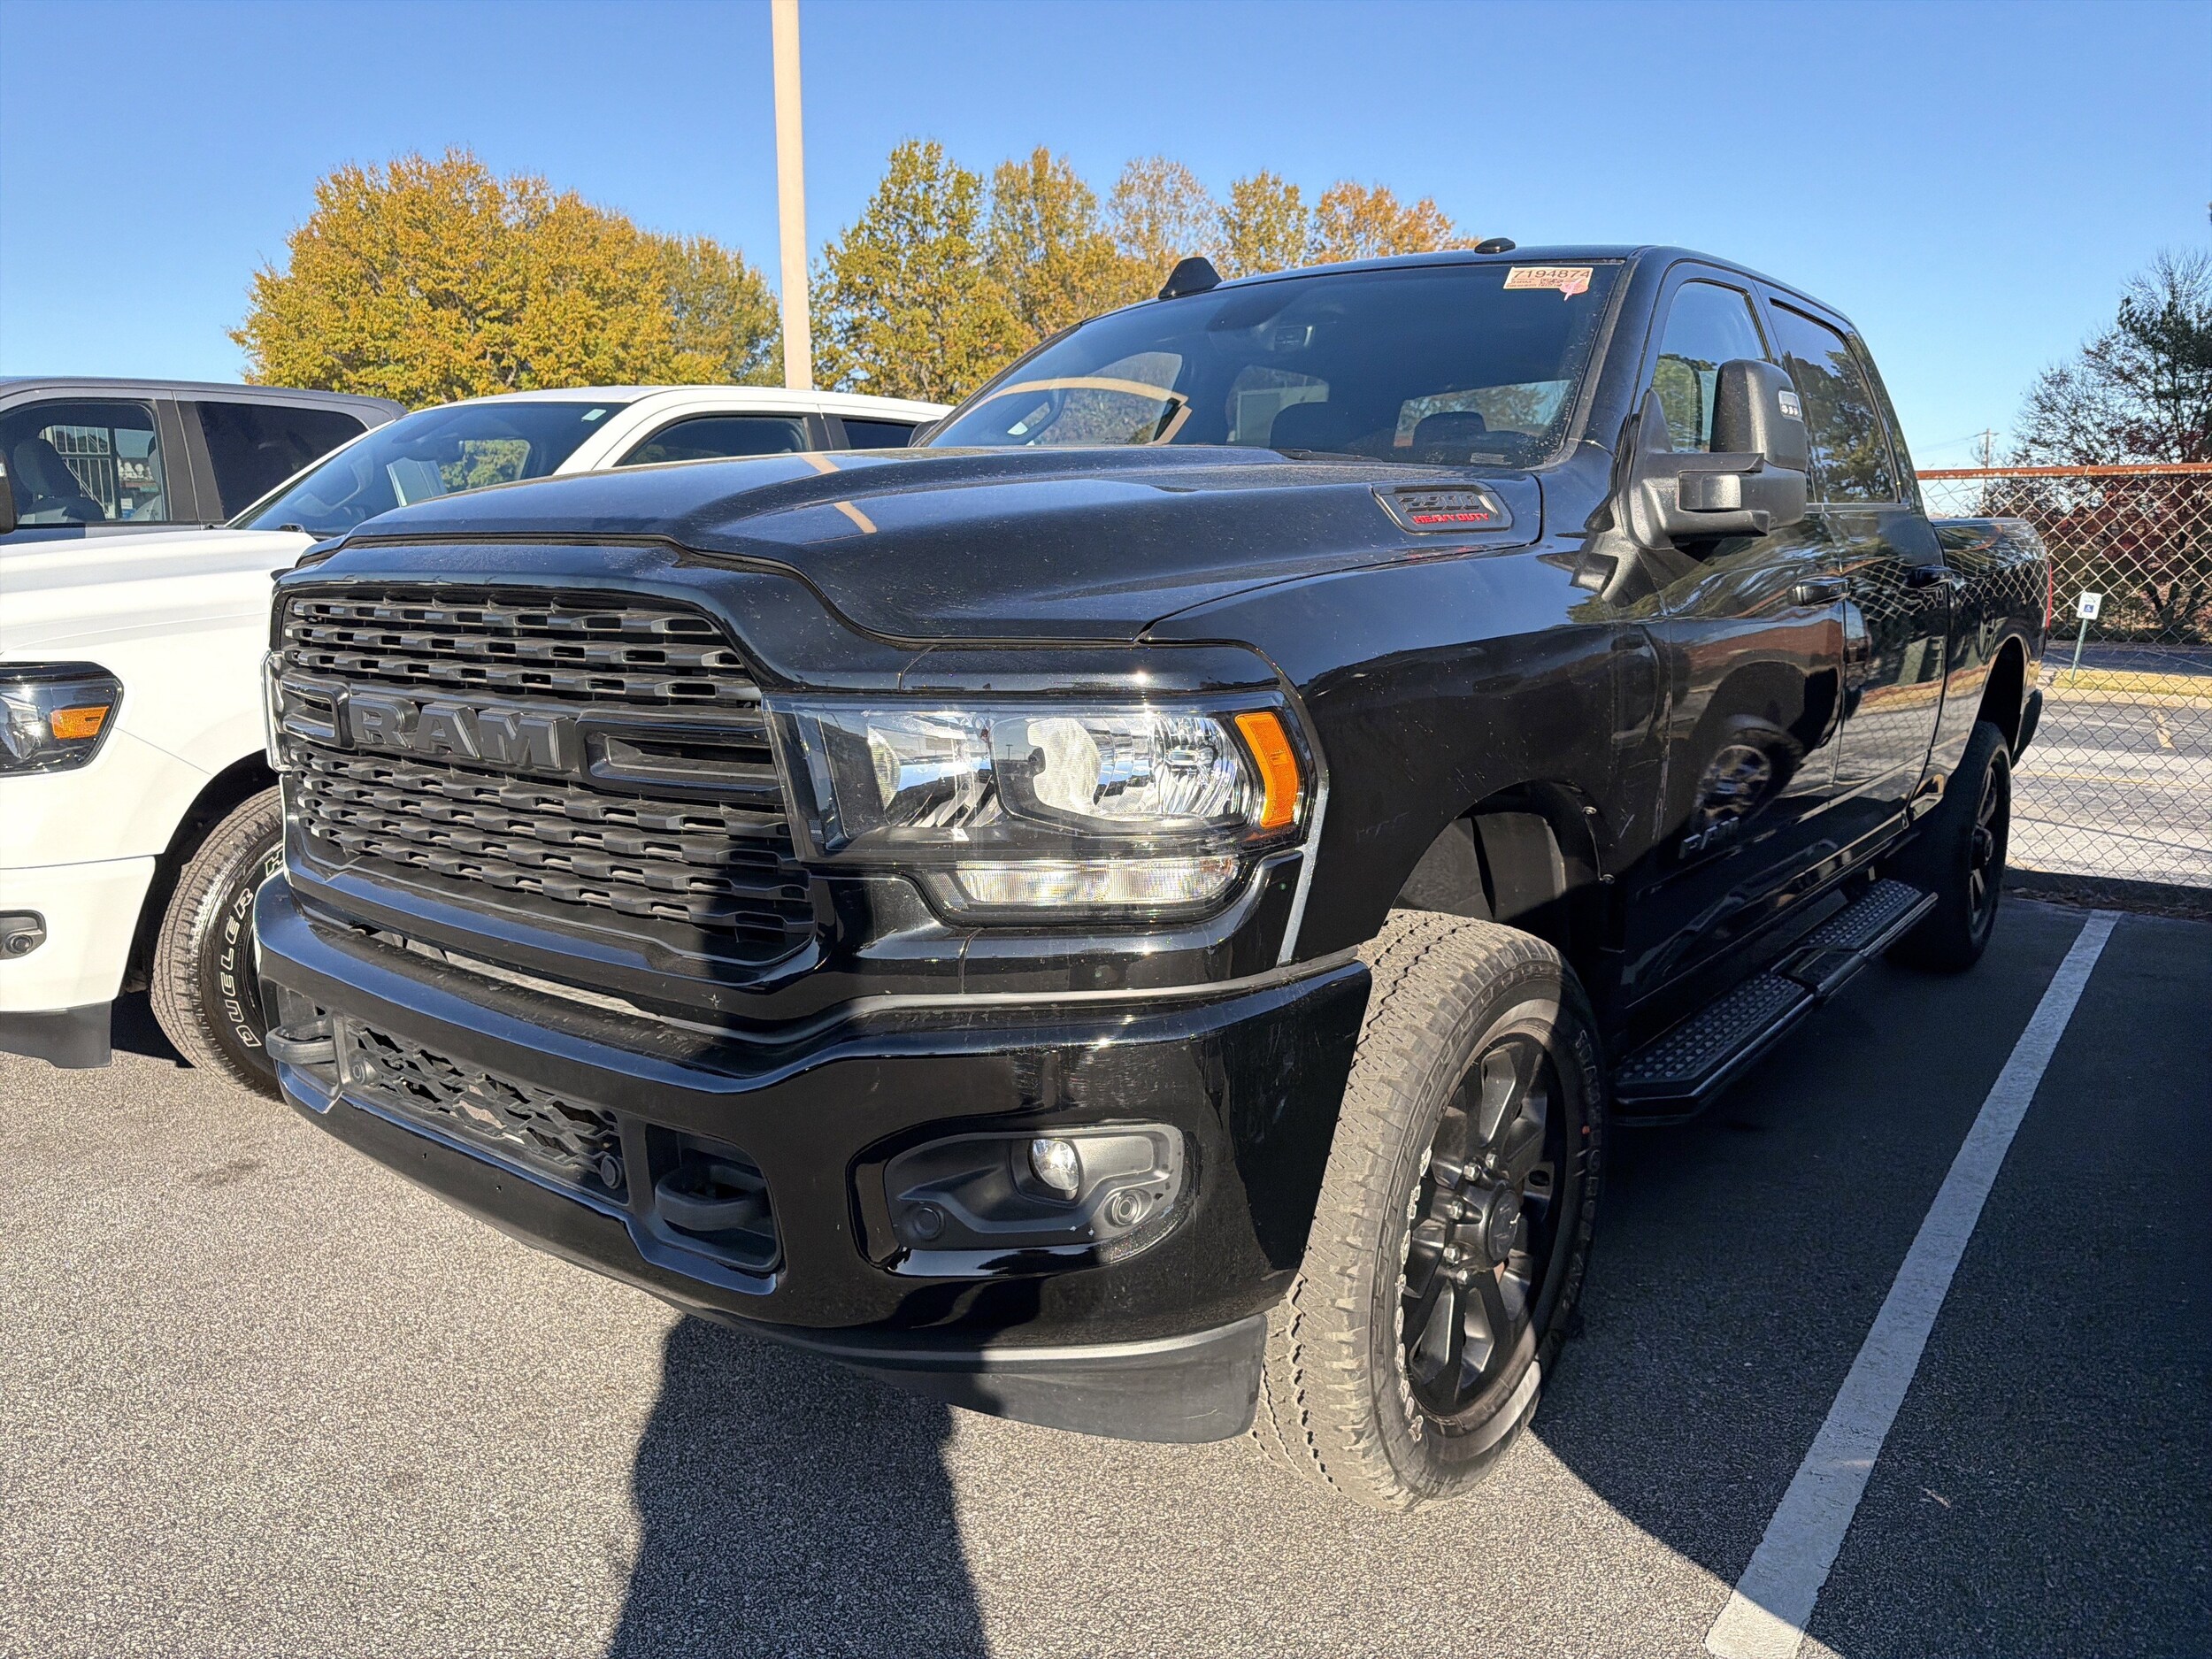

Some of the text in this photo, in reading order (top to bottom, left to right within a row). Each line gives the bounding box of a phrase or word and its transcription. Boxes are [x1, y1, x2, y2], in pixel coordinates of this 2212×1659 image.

[1513, 269, 1591, 280] 7194874
[1412, 512, 1489, 525] HEAVY DUTY
[349, 693, 571, 772] RAM
[219, 887, 262, 1048] DUELER
